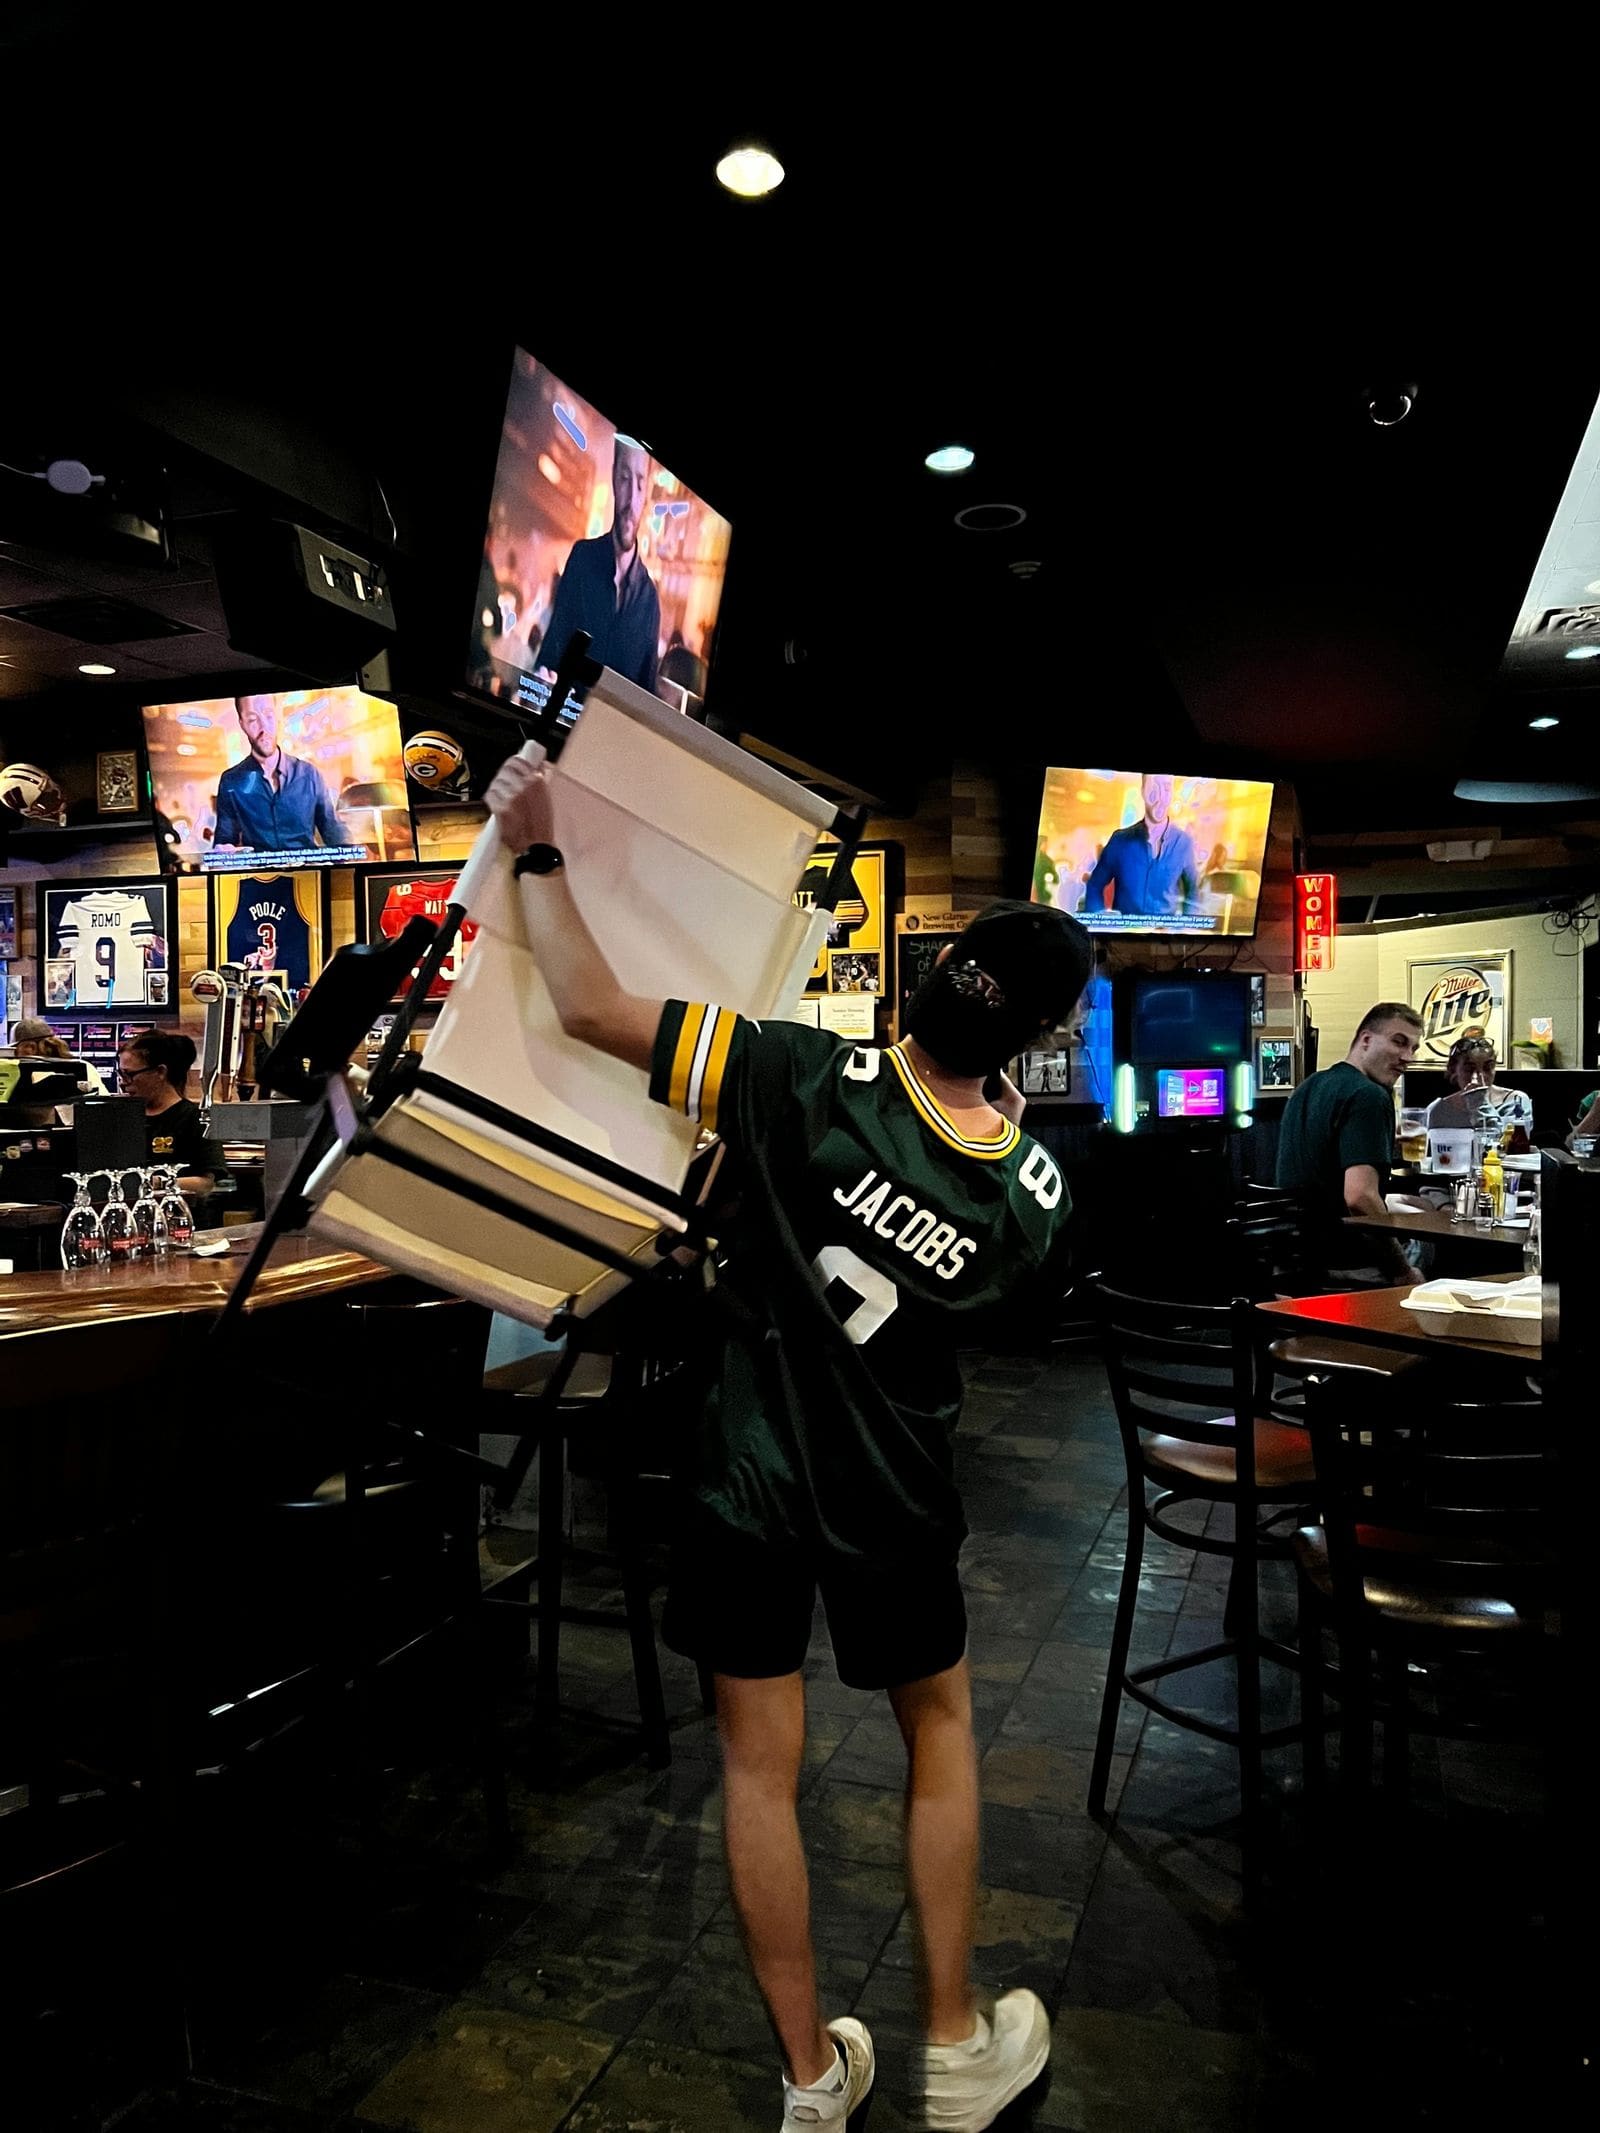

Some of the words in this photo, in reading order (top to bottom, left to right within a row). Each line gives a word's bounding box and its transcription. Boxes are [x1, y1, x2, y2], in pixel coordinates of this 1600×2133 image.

[91, 912, 121, 927] ROMO
[249, 901, 286, 920] POOLE
[791, 891, 814, 907] ATT
[257, 922, 276, 959] 3
[1303, 878, 1324, 969] WOMEN
[95, 937, 116, 987] 9
[1440, 976, 1480, 996] Miller
[1424, 988, 1490, 1040] Lite
[1018, 1144, 1063, 1210] 8
[832, 1169, 978, 1280] JACOBS
